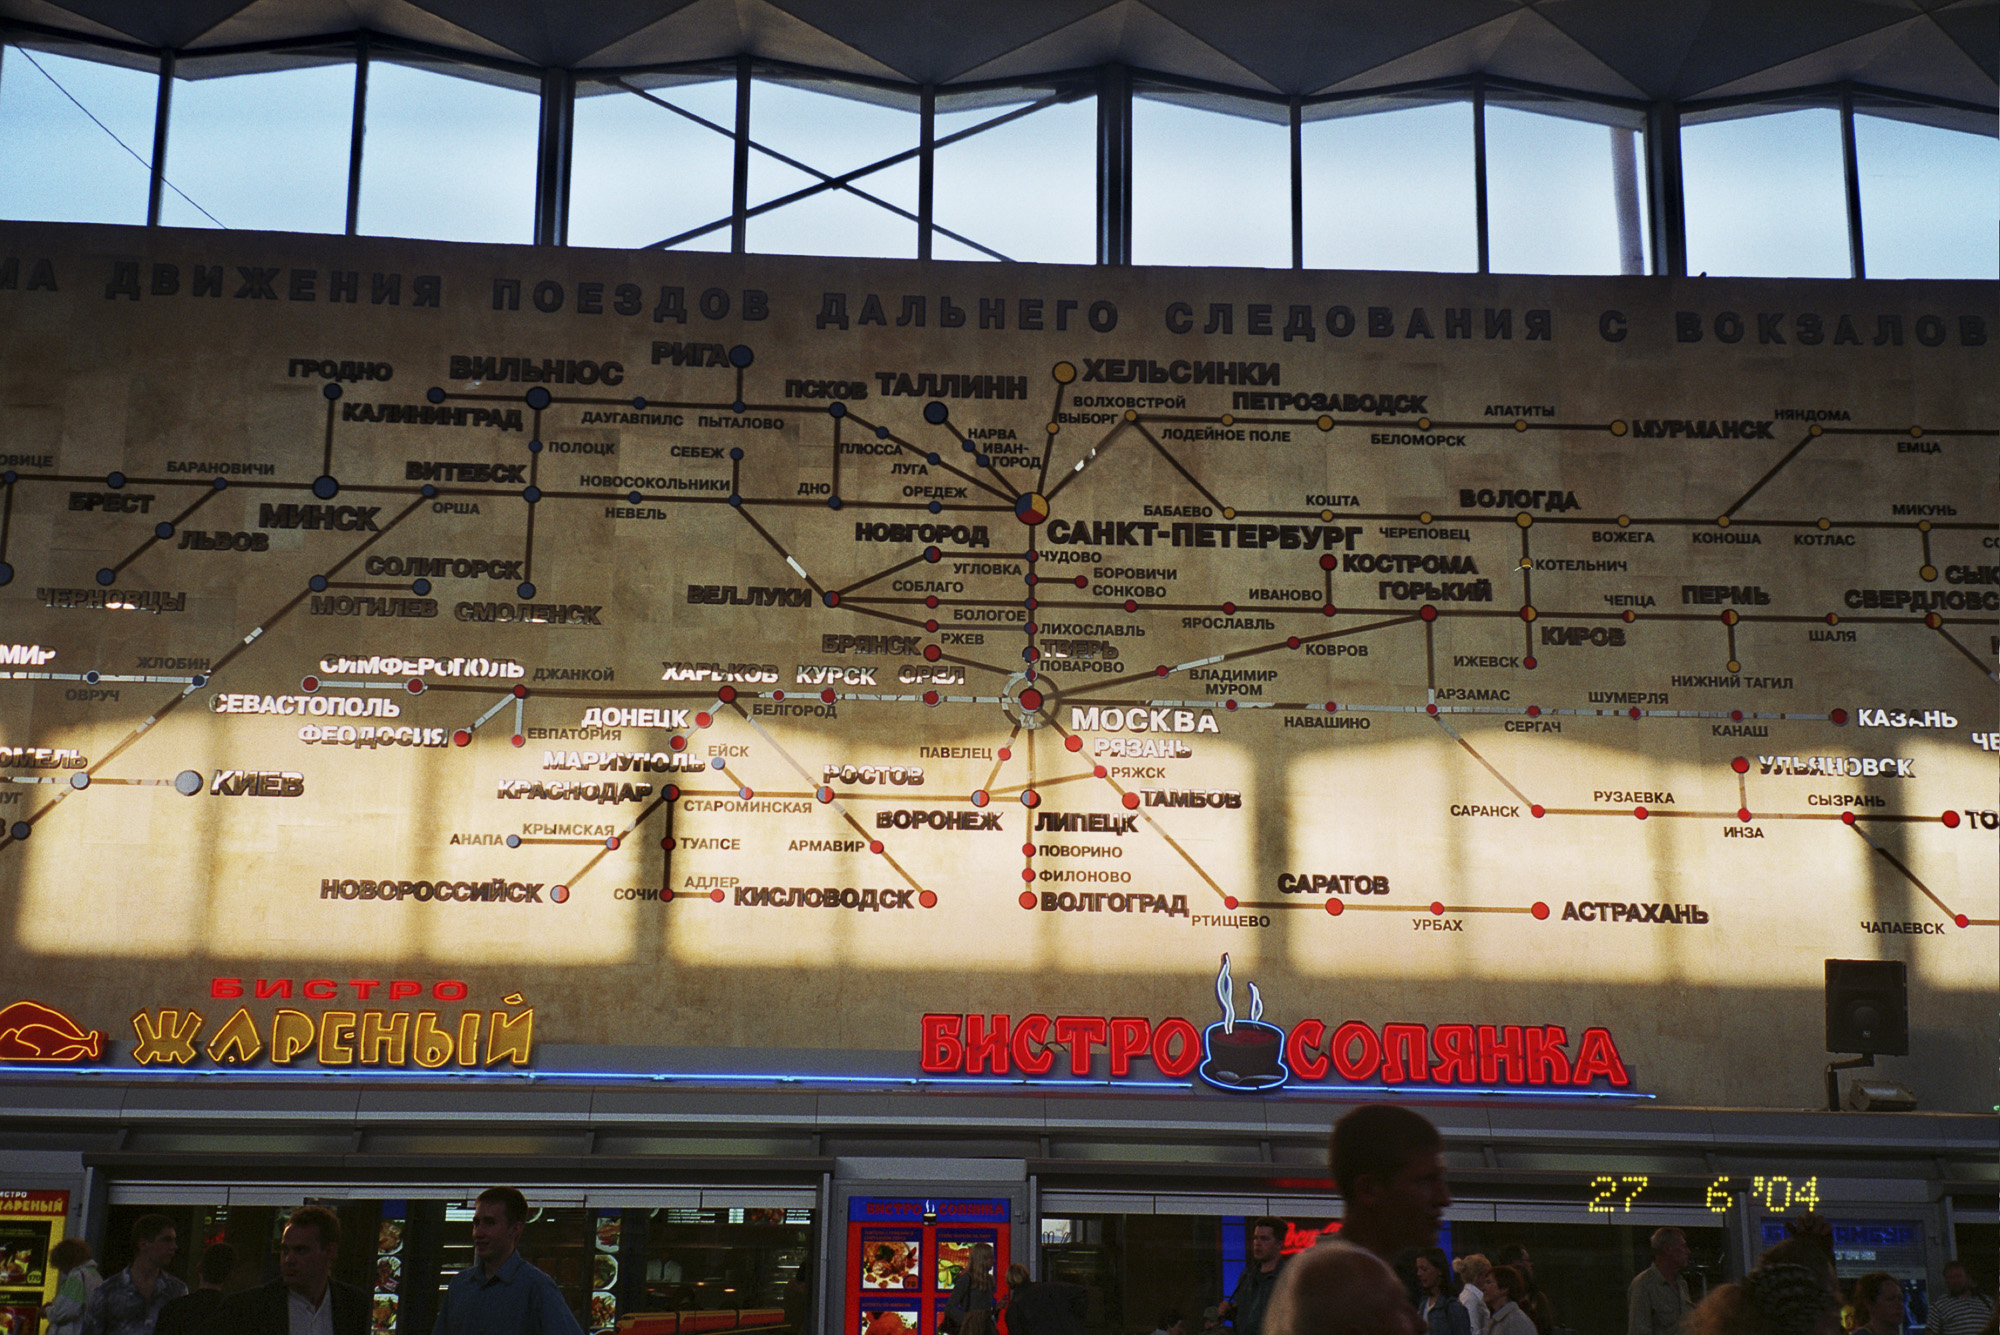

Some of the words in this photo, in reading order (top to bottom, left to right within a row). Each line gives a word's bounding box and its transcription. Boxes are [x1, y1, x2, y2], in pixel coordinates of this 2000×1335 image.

[105, 260, 441, 308] ДВИЖЕНИЯ
[492, 278, 769, 324] ПОЕЗДОВ
[816, 292, 1118, 333] ДАЛЬНЕГО
[1165, 302, 1552, 341] СЛЕДОВАНИЯ
[1599, 310, 1628, 343] С
[1676, 311, 1987, 347] ВОКЗАЛОВ
[651, 342, 729, 367] РИГА
[288, 358, 393, 382] ГРОДНО
[449, 355, 624, 386] ВИЛЬНЮС
[1082, 358, 1280, 387] ХЕЛЬСИНКИ
[785, 379, 869, 400] ПСКОВ
[875, 371, 1028, 400] ТАЛЛИНН
[1073, 395, 1186, 410] ВОЛХОВСТРОЙ
[1232, 391, 1428, 415] ПЕТРОЗАВОДСК
[343, 403, 523, 431] КАЛИНИНГРАД
[581, 411, 684, 426] ДАУГАВПИЛС
[1058, 412, 1118, 425] ВЫБОРГ
[1484, 405, 1555, 417] АПАТИТЫ
[1774, 409, 1851, 422] НЯНДОМА
[699, 416, 784, 430] ПЫТАЛОВО
[1632, 419, 1775, 439] МУРМАНСК
[968, 428, 1017, 441] НАРВА
[1161, 426, 1245, 442] ЛОДЕЙНОЕ
[1250, 429, 1291, 442] ПОЛЕ
[1371, 433, 1466, 447] БЕЛОМОРСК
[549, 442, 615, 456] ПОЛОЦК
[670, 446, 725, 459] СЕБЕЖ
[840, 442, 903, 456] ПЛЮССА
[983, 443, 1029, 455] ИВАН-
[1897, 441, 1943, 455] ЕМЦА
[167, 461, 275, 475] БАРАНОВИЧИ
[891, 463, 928, 476] ЛУГА
[994, 456, 1042, 470] ГОРОД
[405, 461, 527, 484] ВИТЕБСК
[580, 475, 730, 491] НОВОСОКОЛЬНИКИ
[797, 482, 831, 496] ДНО
[902, 485, 967, 500] ОРЕДЕЖ
[67, 491, 156, 514] БРЕСТ
[1306, 495, 1360, 507] КОШТА
[1459, 488, 1583, 513] ВОЛОГДА
[432, 502, 480, 515] ОРША
[605, 507, 667, 520] НЕВЕЛЬ
[1144, 505, 1213, 518] БАБАЕВО
[1892, 504, 1957, 516] МИКУНЬ
[259, 503, 382, 532] МИНСК
[177, 530, 270, 552] ЛЬВОВ
[854, 522, 990, 548] НОВГОРОД
[1047, 519, 1363, 551] САНКТ-ПЕТЕРБУРГ
[1379, 527, 1470, 542] ЧЕРЕПОВЕЦ
[1592, 531, 1655, 544] ВОЖЕГА
[1692, 532, 1762, 546] КОНОША
[1794, 534, 1856, 547] КОТЛАС
[1040, 551, 1102, 564] ЧУДОВО
[1342, 553, 1478, 575] КОСТРОМА
[365, 556, 523, 580] СОЛИГОРСК
[953, 563, 1022, 576] УГЛОВКА
[1535, 559, 1627, 572] КОТЕЛЬНИЧ
[1093, 568, 1178, 581] БОРОВИЧИ
[892, 580, 964, 593] СОБЛАГО
[1092, 585, 1167, 598] СОНКОВО
[1379, 577, 1493, 602] ГОРЬКИЙ
[37, 587, 187, 614] ЧЕРНОВЦЫ
[1249, 588, 1323, 601] ИВАНОВО
[1603, 594, 1656, 609] ЧЕПЦА
[1681, 585, 1772, 606] ПЕРМЬ
[310, 595, 439, 618] МОГИЛЕВ
[454, 601, 602, 626] СМОЛЕНСК
[953, 609, 1026, 622] БОЛОГОЕ
[1040, 623, 1146, 637] ЛИХОСЛАВЛЬ
[1182, 618, 1276, 631] ЯРОСЛАВЛЬ
[941, 633, 985, 646] РЖЕВ
[1541, 626, 1626, 647] КИРОВ
[1809, 630, 1857, 643] ШАЛЯ
[822, 634, 922, 656] БРЯНСК
[1040, 639, 1119, 660] ТВЕРЬ
[1305, 644, 1369, 657] КОВРОВ
[136, 656, 211, 670] ЖЛОБИН
[320, 654, 525, 678] СИМФЕРОПОЛЬ
[1040, 660, 1125, 674] ПОВАРОВО
[1454, 655, 1520, 669] ИЖЕВСК
[533, 667, 615, 682] ДЖАНКОЙ
[661, 661, 779, 683] ХАРЬКОВ
[796, 665, 877, 686] КУРСК
[898, 665, 966, 686] ОРЕЛ
[1189, 669, 1278, 683] ВЛАДИМИР
[1671, 672, 1740, 688] НИЖНИЙ
[1743, 676, 1794, 690] ТАГИЛ
[65, 688, 119, 702] ОВРУЧ
[1206, 683, 1263, 696] МУРОМ
[1436, 689, 1511, 702] АРЗАМАС
[1588, 690, 1669, 705] ШУМЕРЛЯ
[209, 693, 400, 718] СЕВАСТОПОЛЬ
[753, 703, 838, 719] БЕЛГОРОД
[581, 707, 690, 732] ДОНЕЦК
[1071, 706, 1220, 734] МОСКВА
[1283, 716, 1371, 730] НАВАШИНО
[1857, 708, 1958, 729] КАЗАНЬ
[527, 727, 622, 741] ЕВПАТОРИЯ
[1504, 720, 1562, 733] СЕРГАЧ
[1712, 724, 1769, 738] КАНАШ
[297, 724, 450, 749] ФЕОДОСИЯ
[708, 743, 750, 758] ЕЙСК
[920, 747, 992, 761] ПАВЕЛЕЦ
[1094, 737, 1192, 758] РЯЗАНЬ
[542, 751, 706, 773] МАРИУПОЛЬ
[1757, 755, 1916, 778] УЛЬЯНОВСК
[823, 764, 925, 786] РОСТОВ
[1110, 766, 1166, 779] РЯЖСК
[210, 769, 305, 796] КИЕВ
[497, 779, 654, 804] КРАСНОДАР
[1140, 787, 1242, 809] ТАМБОВ
[1593, 790, 1675, 804] РУЗАЕВКА
[684, 800, 813, 814] СТАРОМИНСКАЯ
[1808, 794, 1886, 808] СЫЗРАНЬ
[1450, 804, 1520, 818] САРАНСК
[875, 809, 1004, 832] ВОРОНЕЖ
[1034, 812, 1139, 836] ЛИПЕЦК
[522, 823, 616, 837] КРЫМСКАЯ
[1724, 826, 1765, 839] ИНЗА
[450, 833, 504, 846] АНАПА
[681, 837, 741, 851] ТУАПСЕ
[788, 839, 866, 853] АРМАВИР
[1039, 845, 1123, 858] ПОВОРИНО
[684, 876, 740, 890] АДЛЕР
[1039, 869, 1132, 883] ФИЛОНОВО
[320, 877, 544, 904] НОВОРОССИЙСК
[1277, 873, 1390, 896] САРАТОВ
[613, 887, 661, 901] СОЧИ
[734, 886, 915, 912] КИСЛОВОДСК
[1041, 891, 1189, 918] ВОЛГОГРАД
[1561, 901, 1709, 925] АСТРАХАНЬ
[1191, 914, 1270, 928] РТИЩЕВО
[1413, 918, 1464, 932] УРБАХ
[1861, 920, 1945, 935] ЧАПАЕВСК
[211, 978, 468, 1000] БИСТРО
[131, 992, 535, 1068] ЖАРЕНЫЙ
[920, 1013, 1200, 1075] БИСТРО
[1285, 1018, 1632, 1086] СОЛЯНКА
[866, 1202, 922, 1215] БИСТРО
[938, 1203, 1005, 1216] СОЛЯНКА
